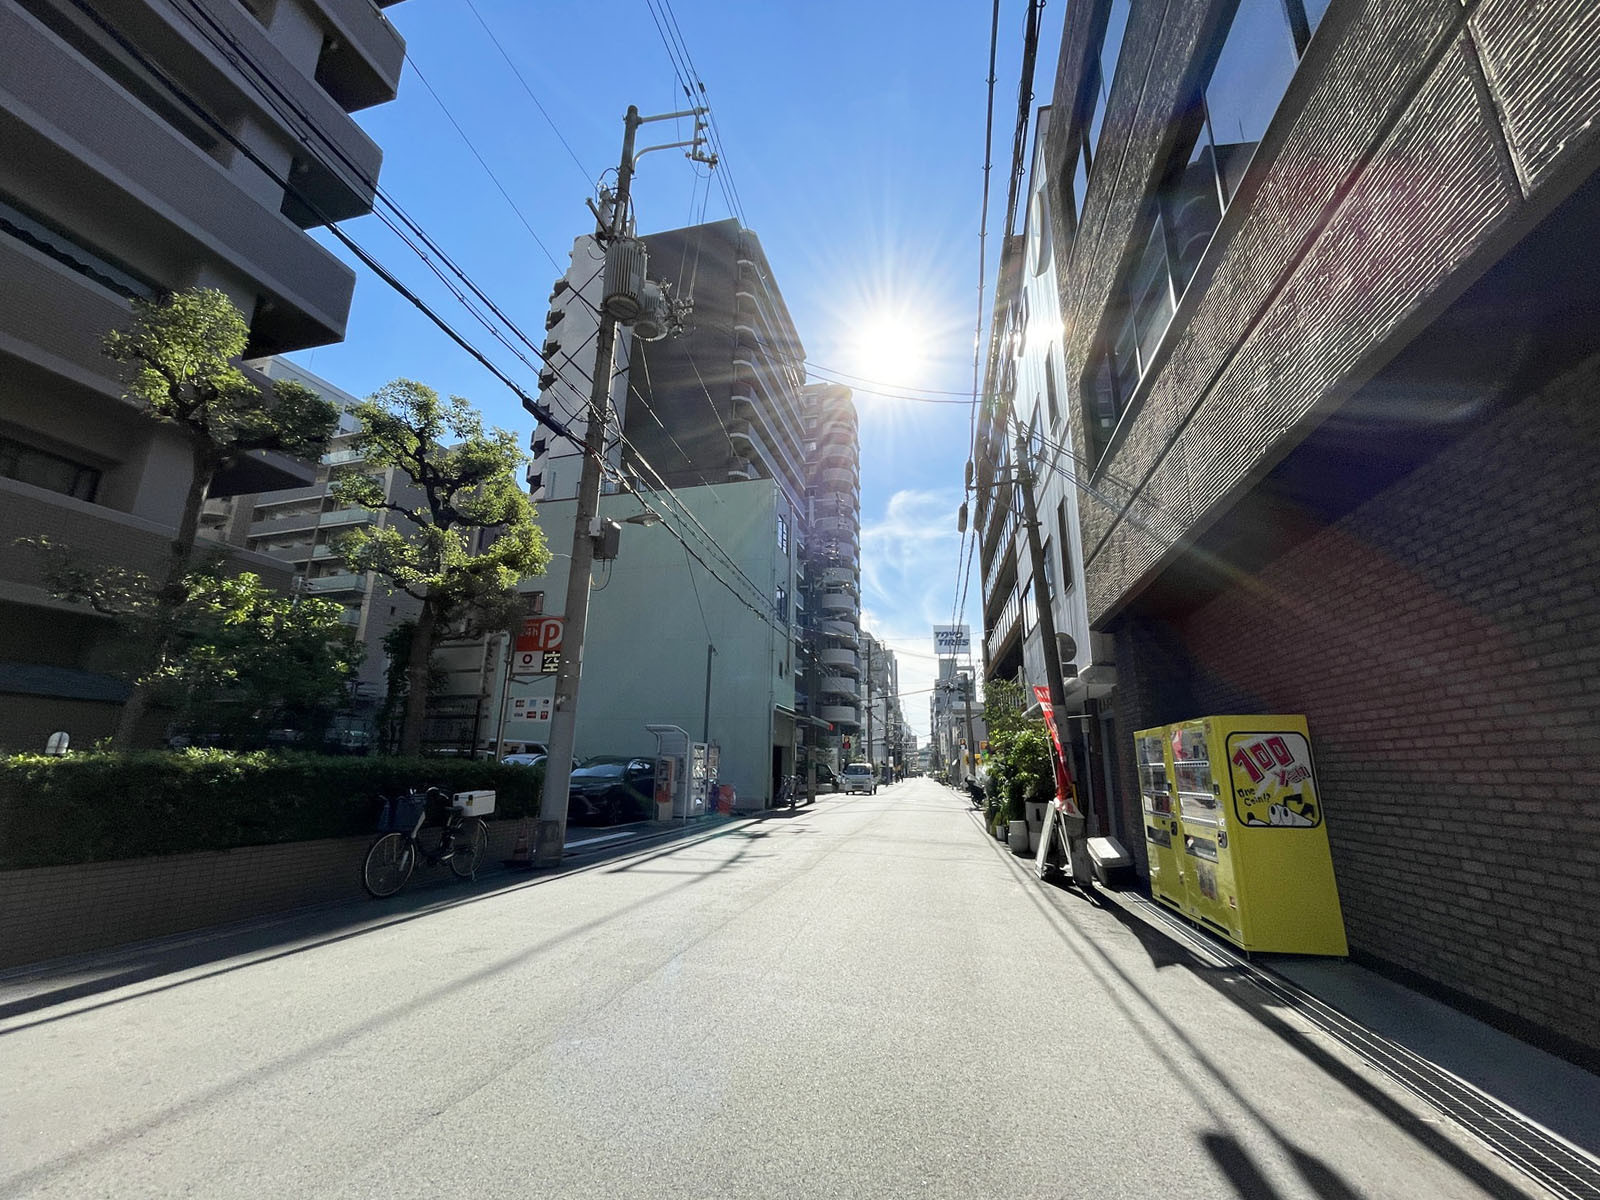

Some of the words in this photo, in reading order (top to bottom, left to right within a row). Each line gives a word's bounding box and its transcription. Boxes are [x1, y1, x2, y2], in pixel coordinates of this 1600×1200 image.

[538, 619, 564, 649] P
[935, 631, 964, 639] TOYO
[938, 638, 970, 647] TIRES
[1232, 736, 1296, 784] 100
